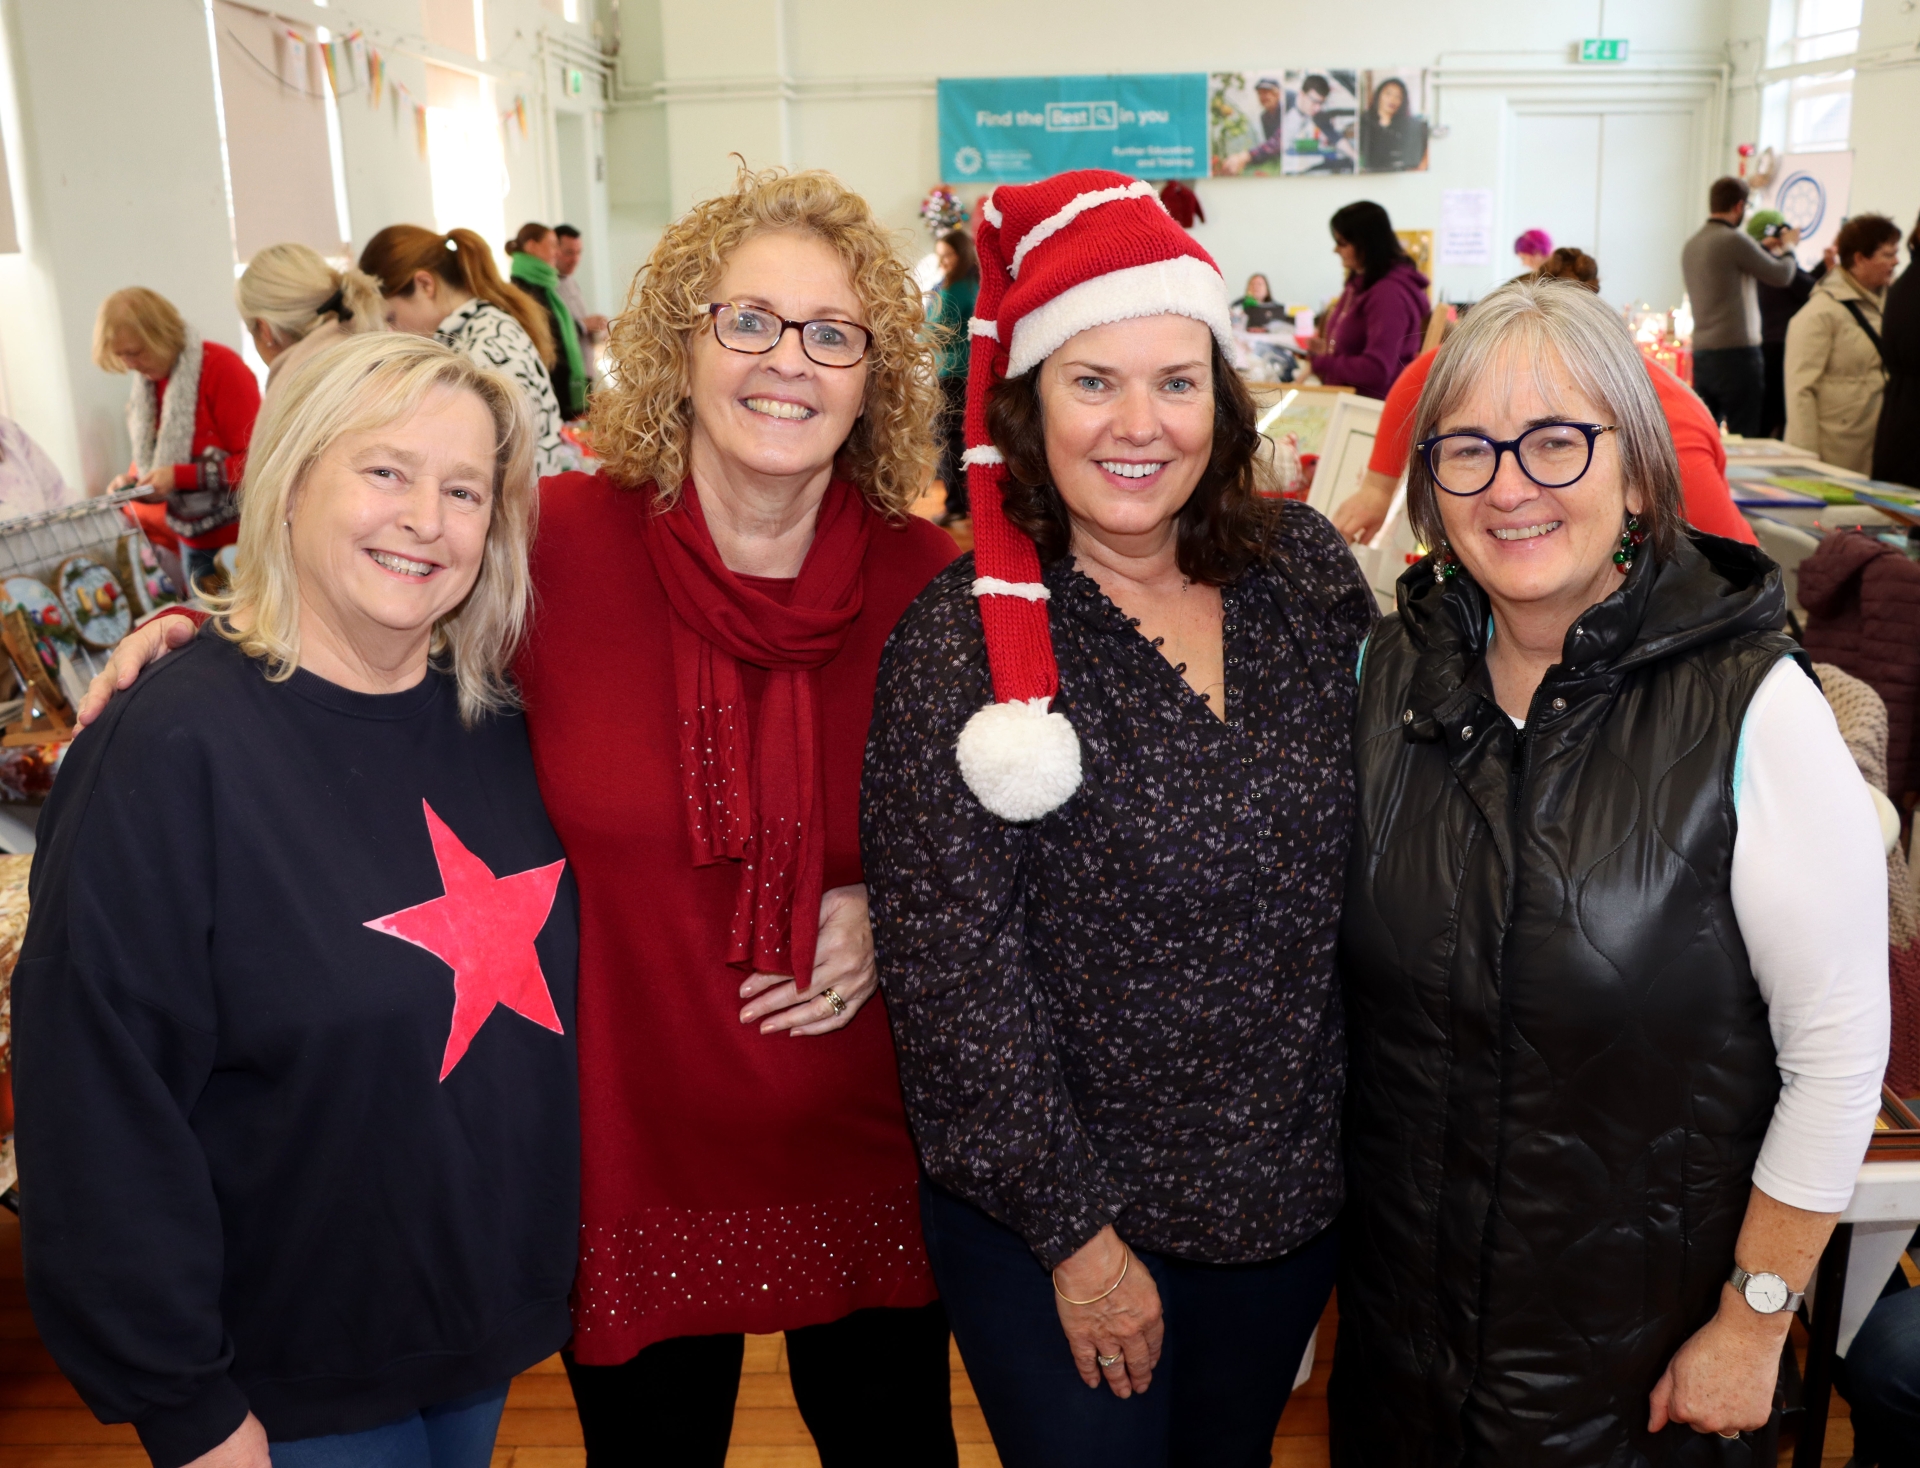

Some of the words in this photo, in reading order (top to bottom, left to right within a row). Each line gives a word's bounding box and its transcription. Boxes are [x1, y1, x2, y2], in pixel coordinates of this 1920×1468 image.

[976, 111, 1013, 126] Find
[1016, 110, 1044, 126] the
[1052, 109, 1087, 125] Best
[1119, 108, 1135, 123] in
[1138, 110, 1169, 127] you
